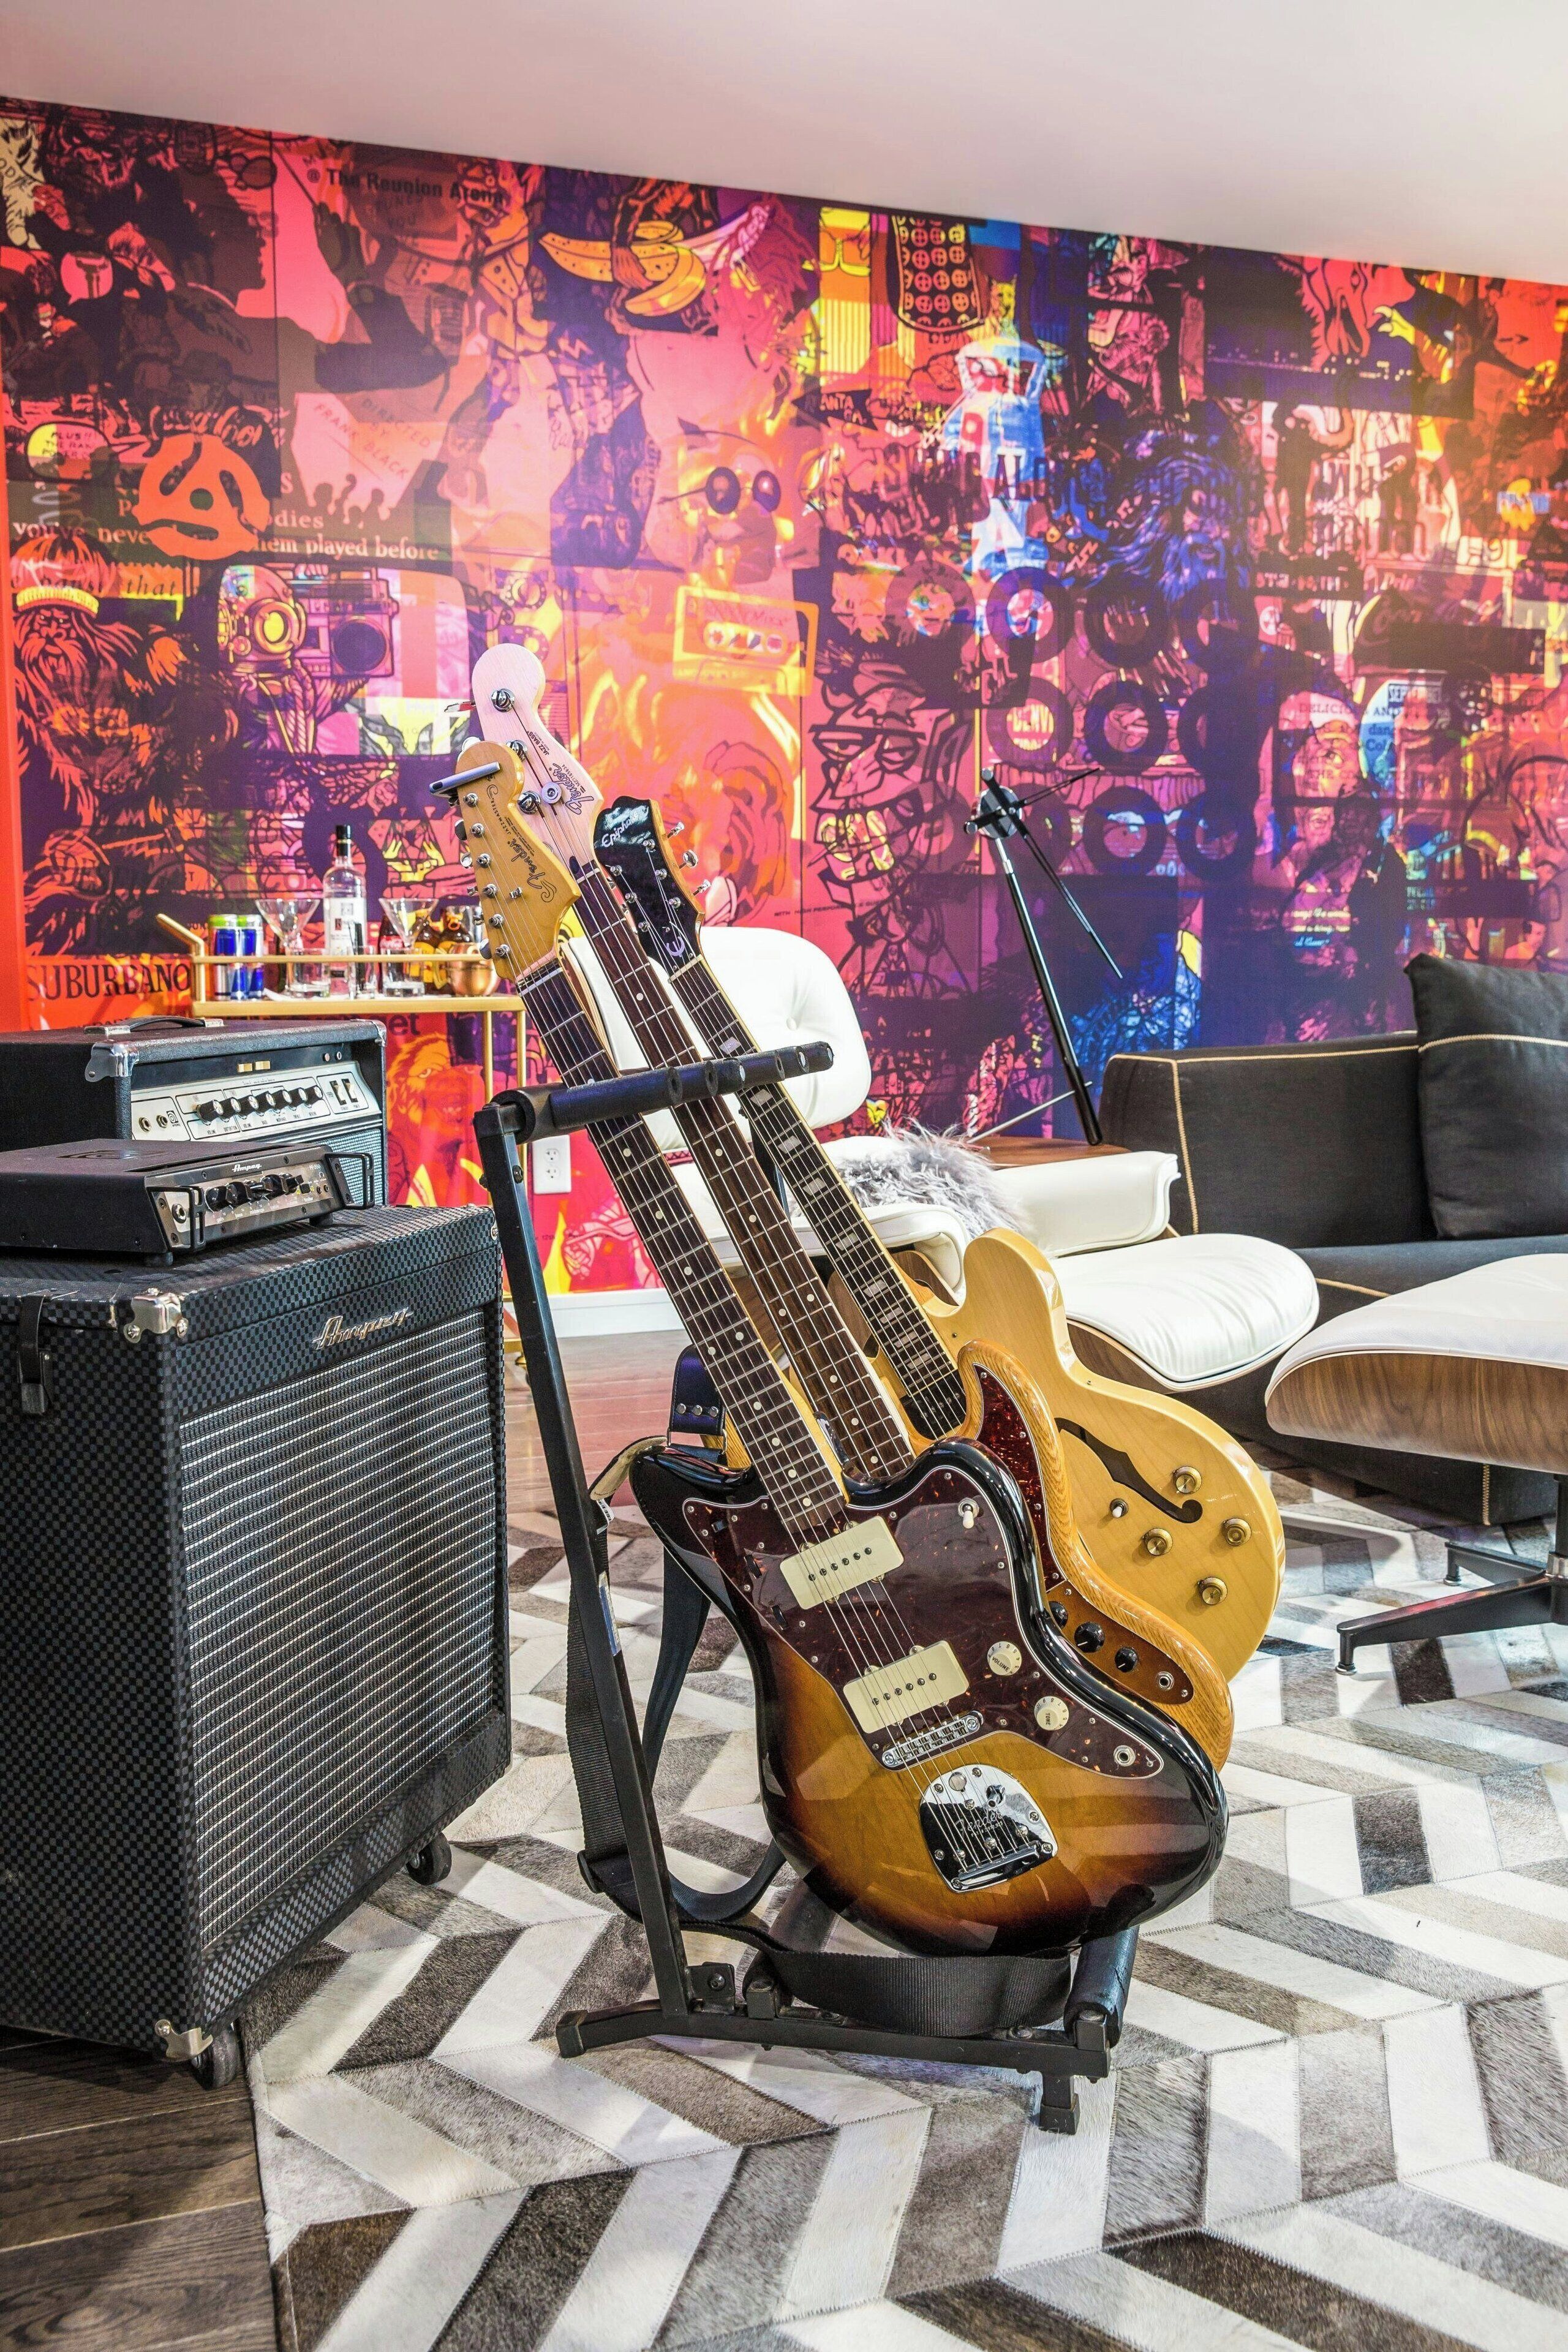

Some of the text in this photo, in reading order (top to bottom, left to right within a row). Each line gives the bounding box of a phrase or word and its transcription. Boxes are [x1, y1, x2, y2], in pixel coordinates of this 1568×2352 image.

[368, 174, 443, 197] Reunion
[314, 402, 359, 440] FRANK
[364, 440, 410, 480] BLACK
[306, 533, 369, 560] played
[374, 535, 440, 560] before
[126, 575, 176, 595] that
[529, 731, 550, 756] JAZZ BASS
[552, 763, 595, 816] Fender
[489, 798, 511, 835] JAZZMASTER
[509, 838, 546, 889] Fender
[27, 962, 192, 1002] SUBURBANO
[232, 1163, 262, 1173] Ampeg
[312, 1306, 414, 1351] Ampeg
[992, 1656, 1010, 1672] VOLUME
